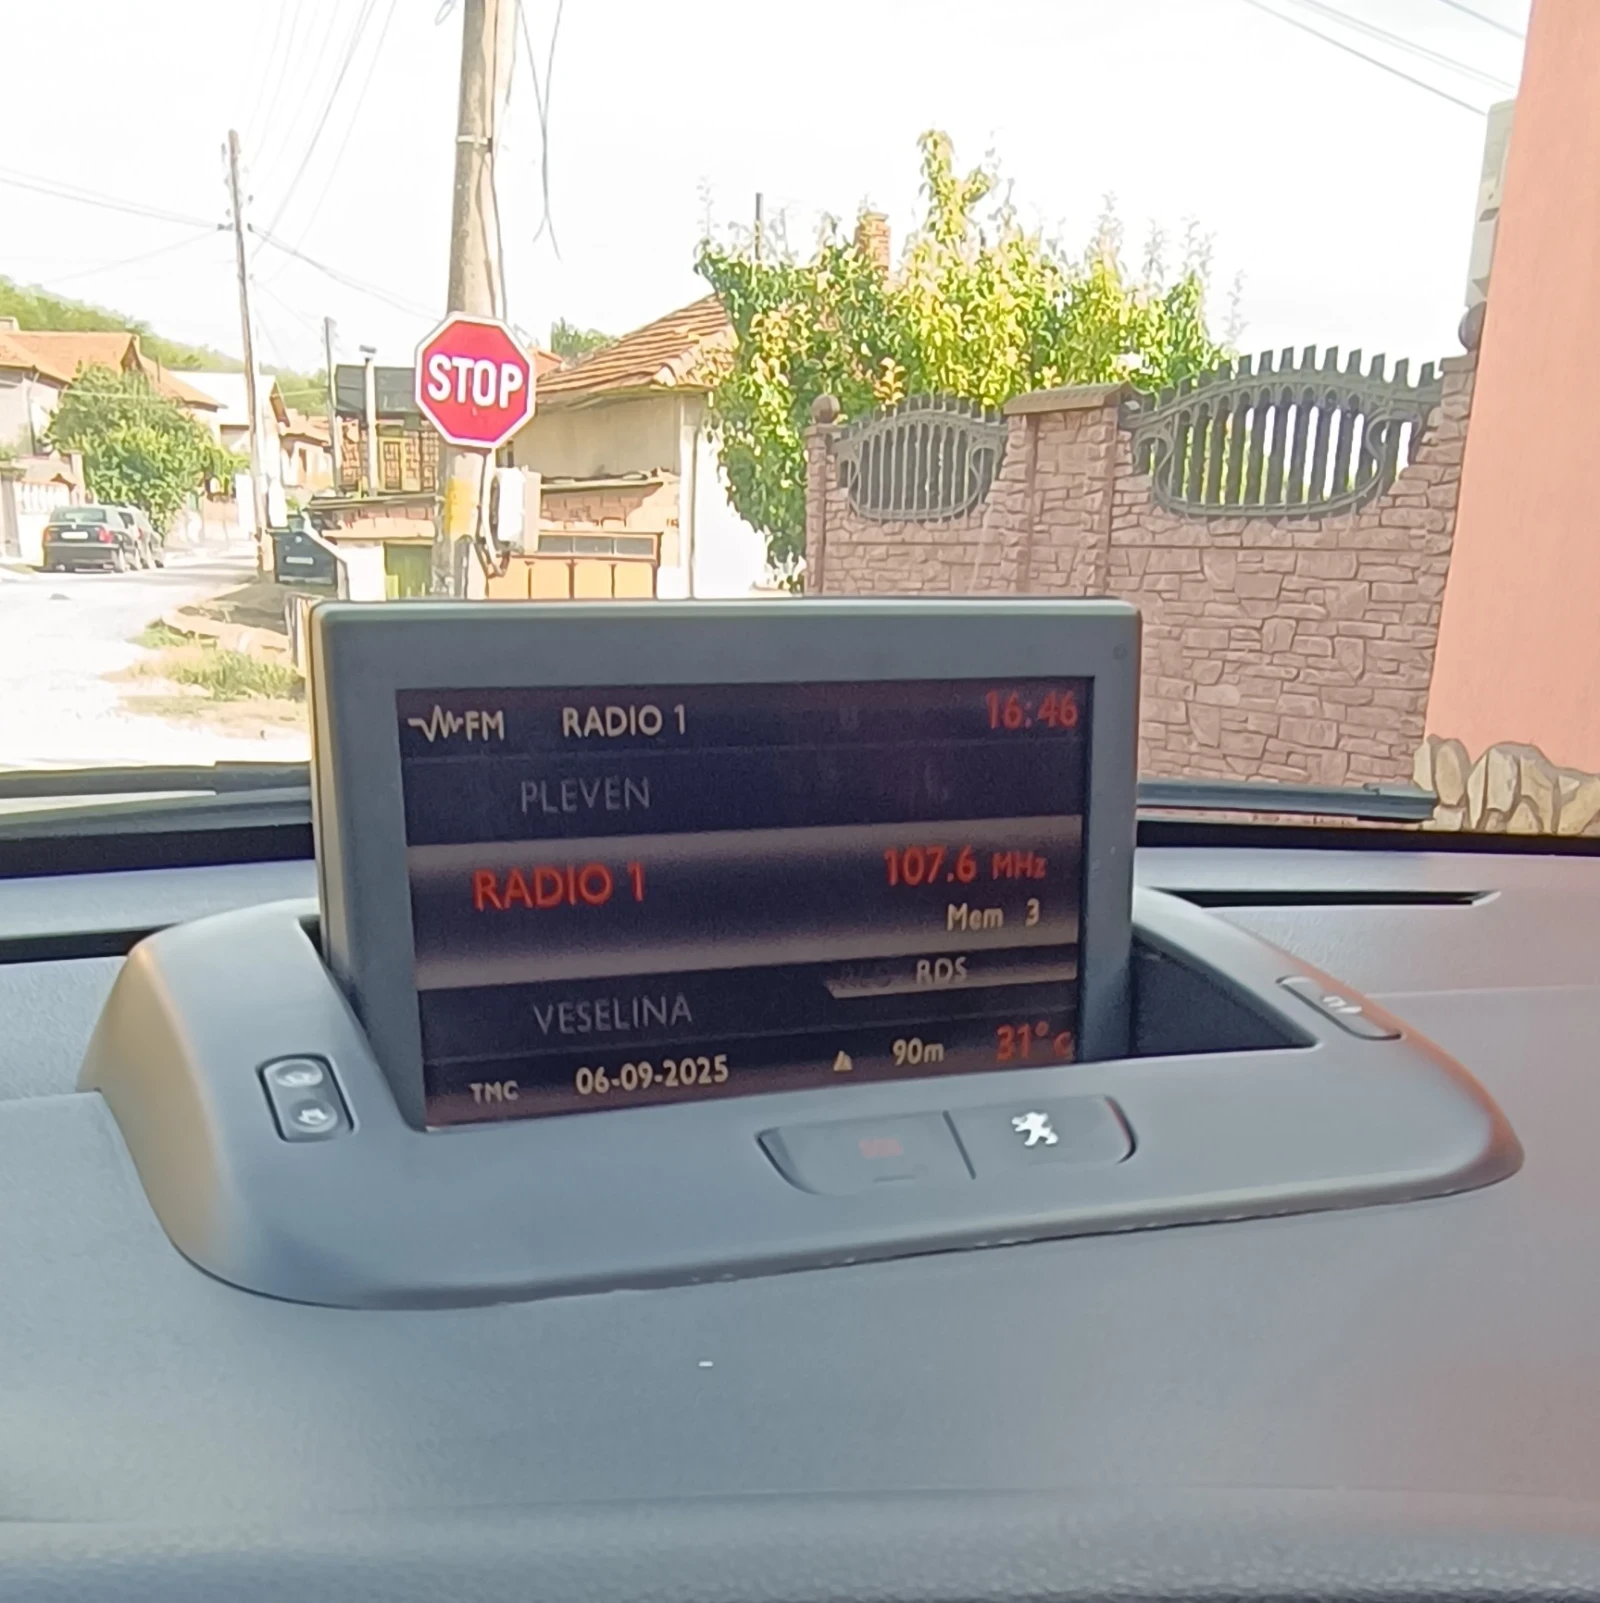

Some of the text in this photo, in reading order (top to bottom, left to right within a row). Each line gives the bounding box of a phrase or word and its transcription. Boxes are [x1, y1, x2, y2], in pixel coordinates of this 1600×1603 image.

[427, 353, 524, 409] STOP
[465, 709, 505, 741] FM
[562, 704, 686, 739] RADIO 1
[985, 690, 1079, 730] 16:46
[521, 777, 650, 813] PLEVEN
[884, 845, 1048, 887] 107.6 MHz
[474, 861, 646, 911] RADIO 1
[946, 898, 1040, 932] Mem 3
[916, 956, 969, 986] RDS
[532, 994, 693, 1034] VESELINA
[892, 1037, 945, 1066] 90m
[468, 1079, 520, 1105] TMC
[575, 1054, 730, 1096] 06-09-2025
